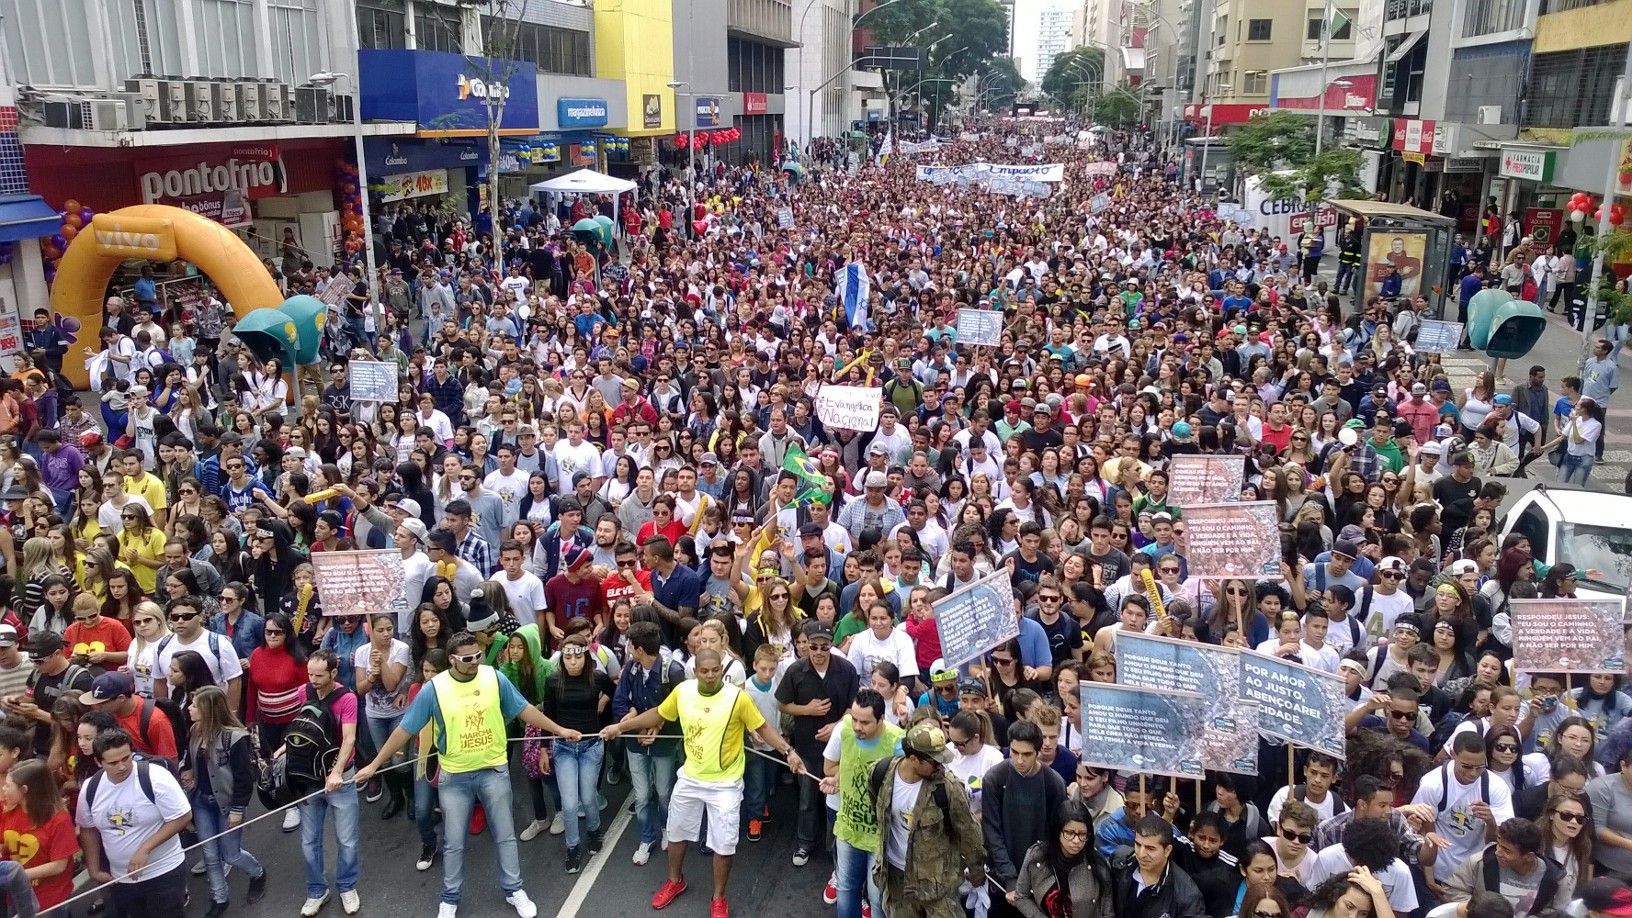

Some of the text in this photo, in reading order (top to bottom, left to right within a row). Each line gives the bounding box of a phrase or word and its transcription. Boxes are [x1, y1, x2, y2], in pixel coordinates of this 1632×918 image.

[141, 158, 274, 204] pontofrio
[96, 224, 160, 250] vivo
[1244, 663, 1306, 689] POR AMOR
[1245, 676, 1306, 703] AO JUSTO,
[1246, 688, 1321, 719] ABENÇOAREI
[460, 728, 492, 739] MARCHA
[463, 734, 493, 748] JESUS
